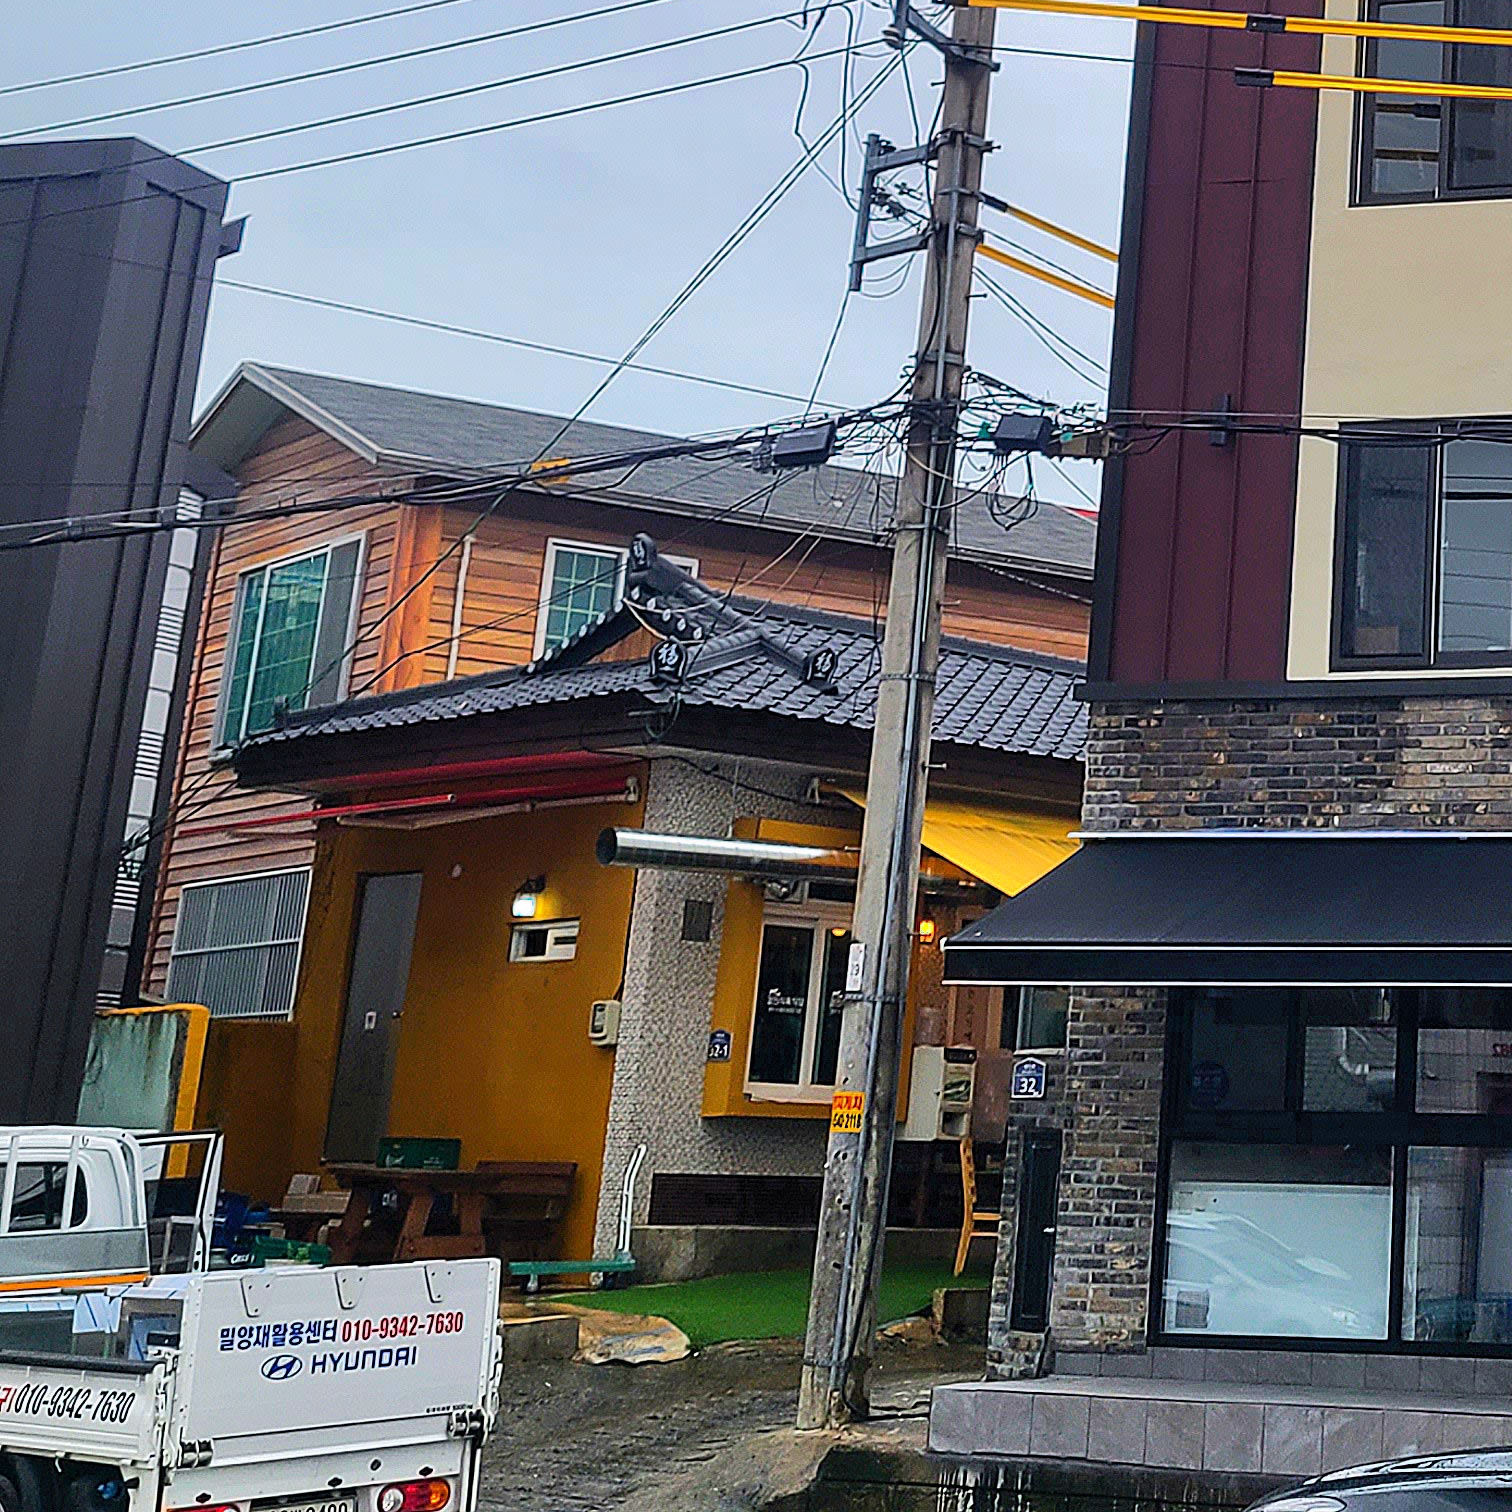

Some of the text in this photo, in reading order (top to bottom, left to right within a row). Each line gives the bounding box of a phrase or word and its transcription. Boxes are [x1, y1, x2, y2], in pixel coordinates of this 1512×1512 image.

[1019, 1077, 1037, 1093] 32
[219, 1311, 465, 1352] 밀양재활용센터 010-9342-7630
[310, 1345, 418, 1375] HYUNDAI
[14, 1383, 137, 1424] 010-9342-7630
